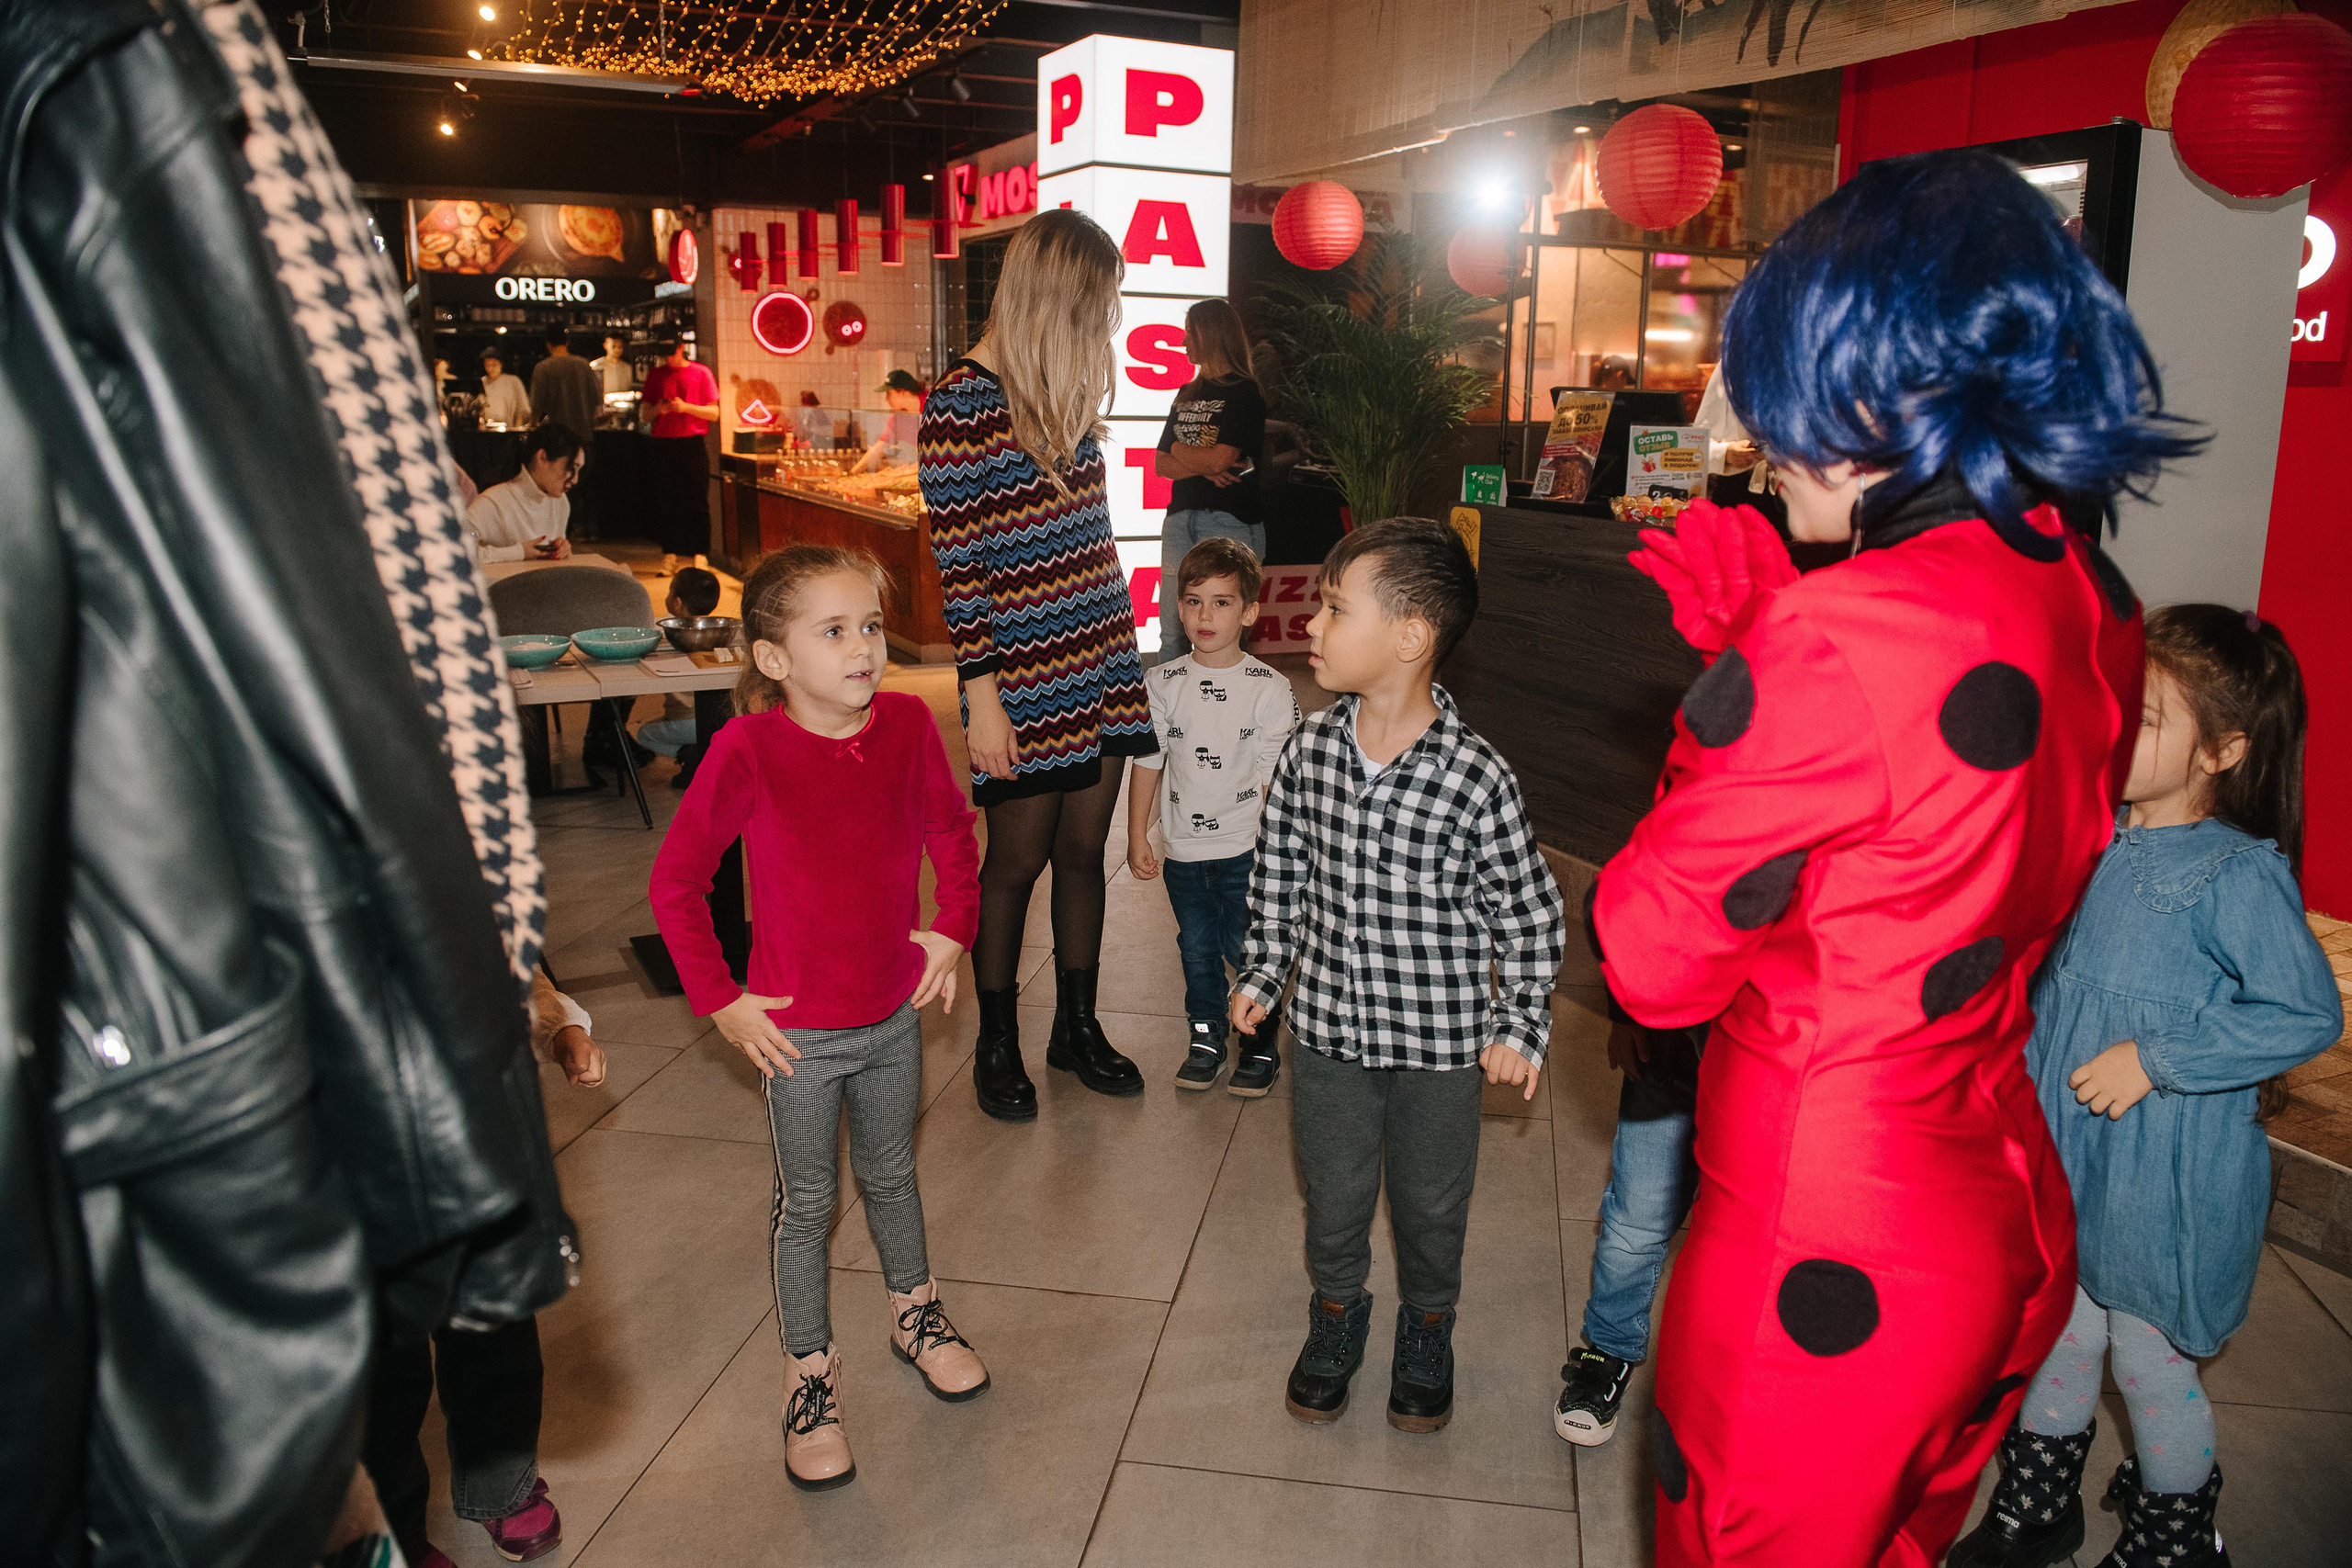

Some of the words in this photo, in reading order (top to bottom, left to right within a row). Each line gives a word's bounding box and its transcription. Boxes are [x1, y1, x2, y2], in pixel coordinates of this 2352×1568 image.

[494, 276, 596, 303] ORERO
[2290, 310, 2328, 342] od
[1637, 434, 1674, 445] ОСТАВЬ
[1245, 667, 1273, 676] KARL
[1168, 727, 1183, 735] ARL
[1996, 1511, 2020, 1529] reima
[2112, 1551, 2128, 1568] eima
